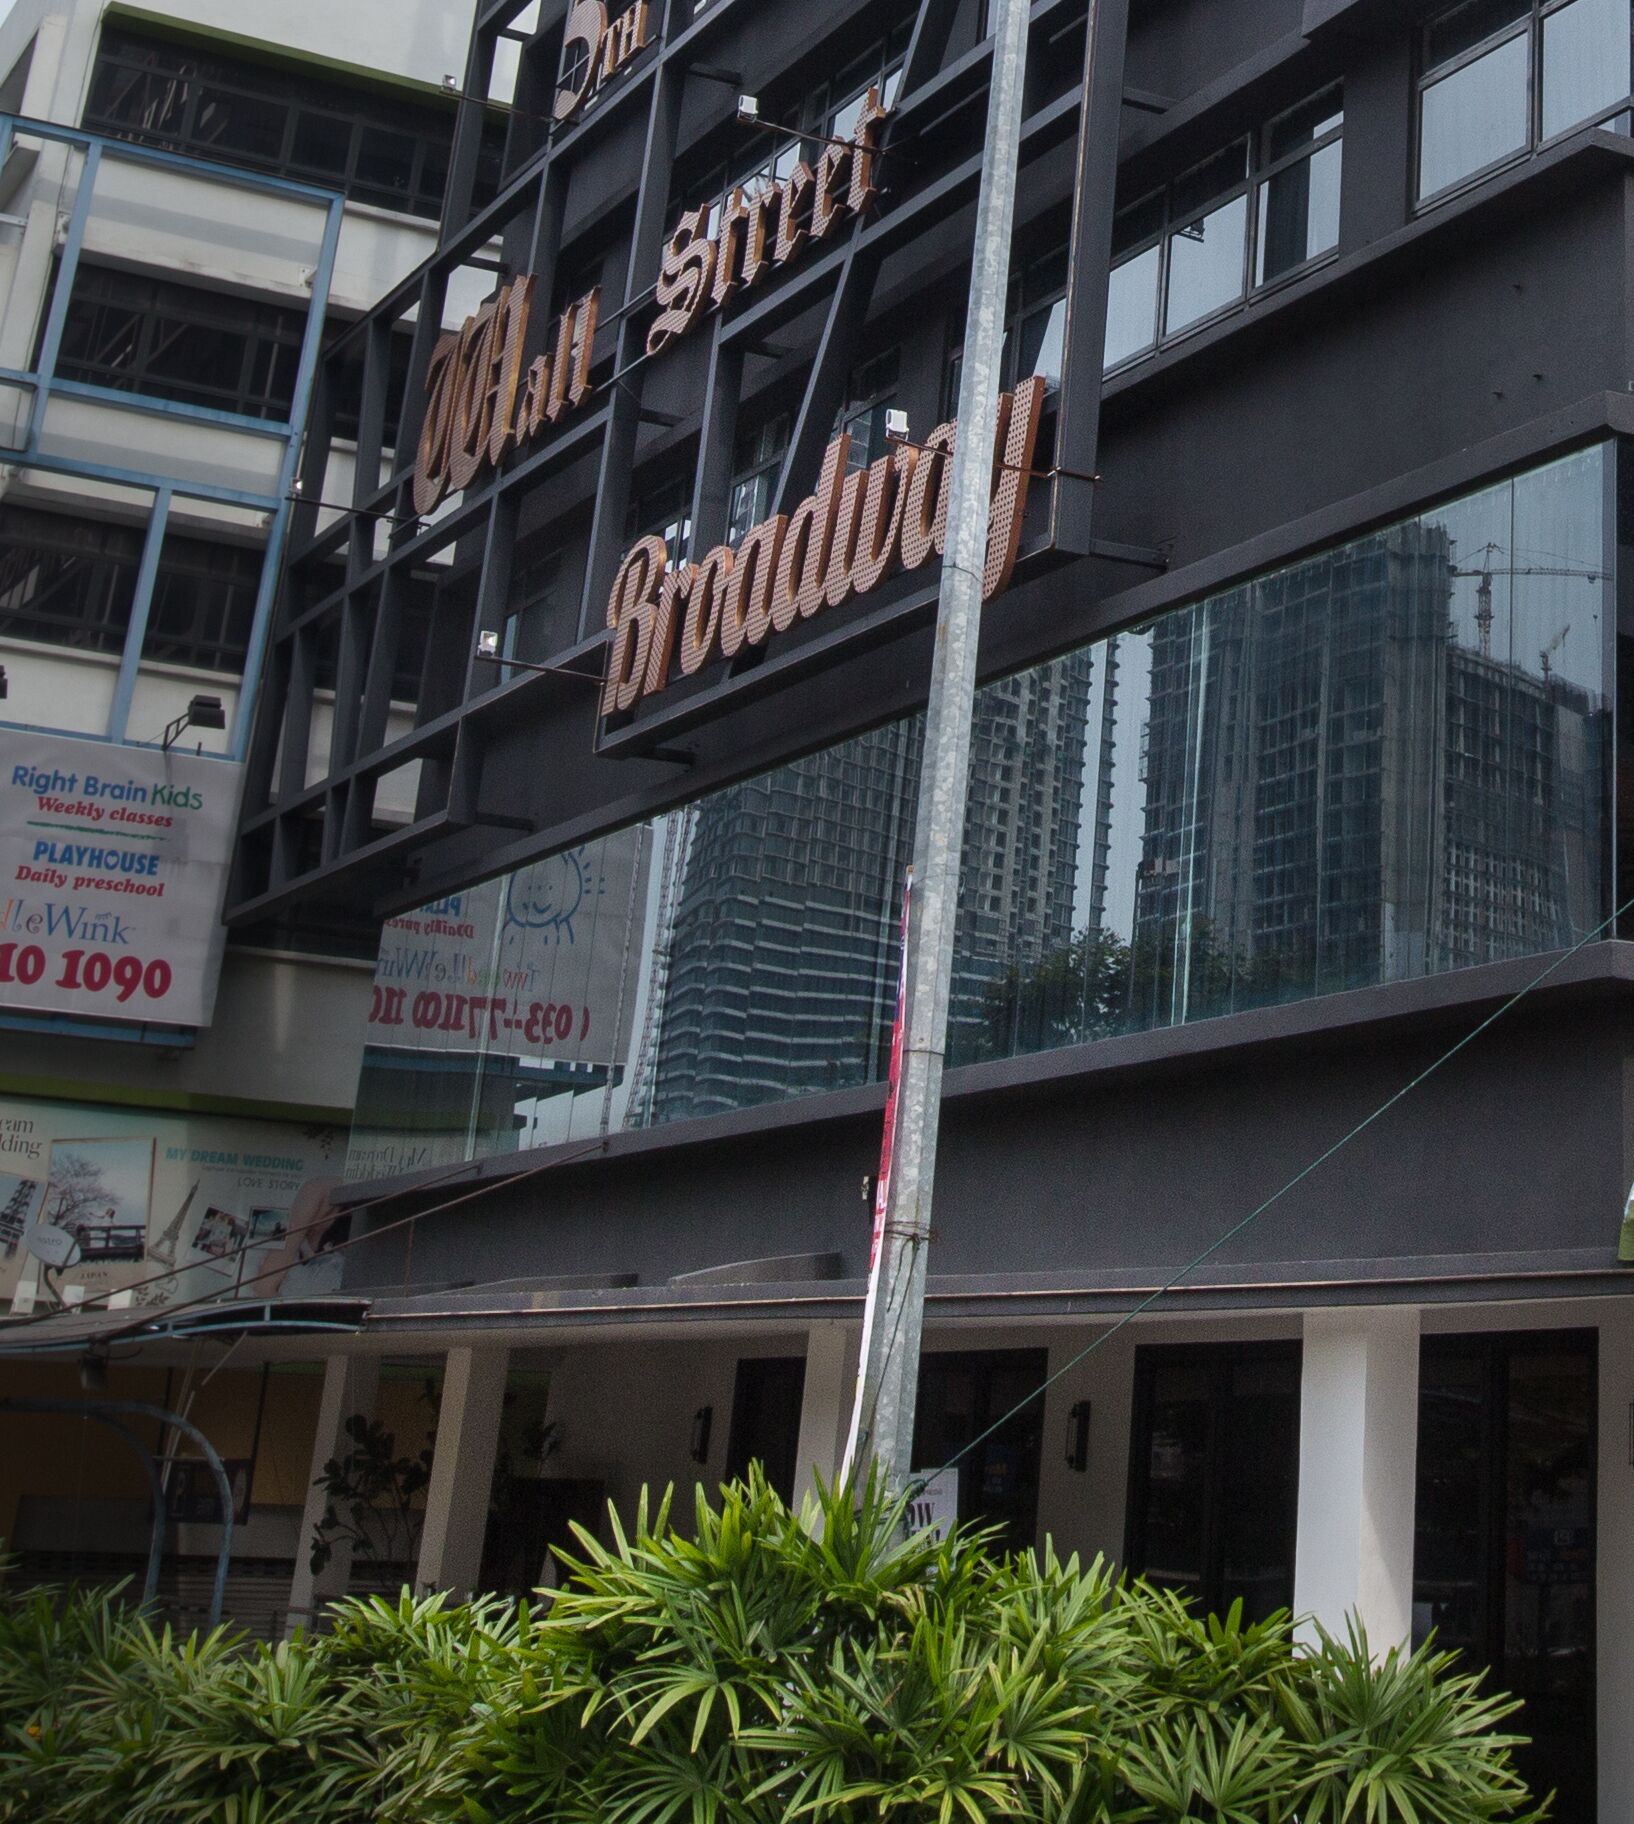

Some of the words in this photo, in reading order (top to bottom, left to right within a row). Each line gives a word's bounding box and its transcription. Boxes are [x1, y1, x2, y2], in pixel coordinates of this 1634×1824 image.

[646, 86, 887, 356] Street
[601, 375, 1047, 717] Broadway
[11, 765, 78, 795] Right
[83, 774, 148, 803] Brain
[149, 782, 204, 811] Kids
[37, 795, 105, 822] Weekly
[109, 806, 174, 828] classes
[32, 840, 161, 876] PLAYHOUSE
[15, 864, 68, 888] Daily
[72, 872, 165, 898] preschool
[55, 948, 172, 1004] 1090
[165, 1146, 188, 1162] MY
[190, 1149, 240, 1166] DREAM
[242, 1152, 305, 1171] WEDDING
[237, 1175, 266, 1189] LOVE
[268, 1177, 303, 1191] STORY
